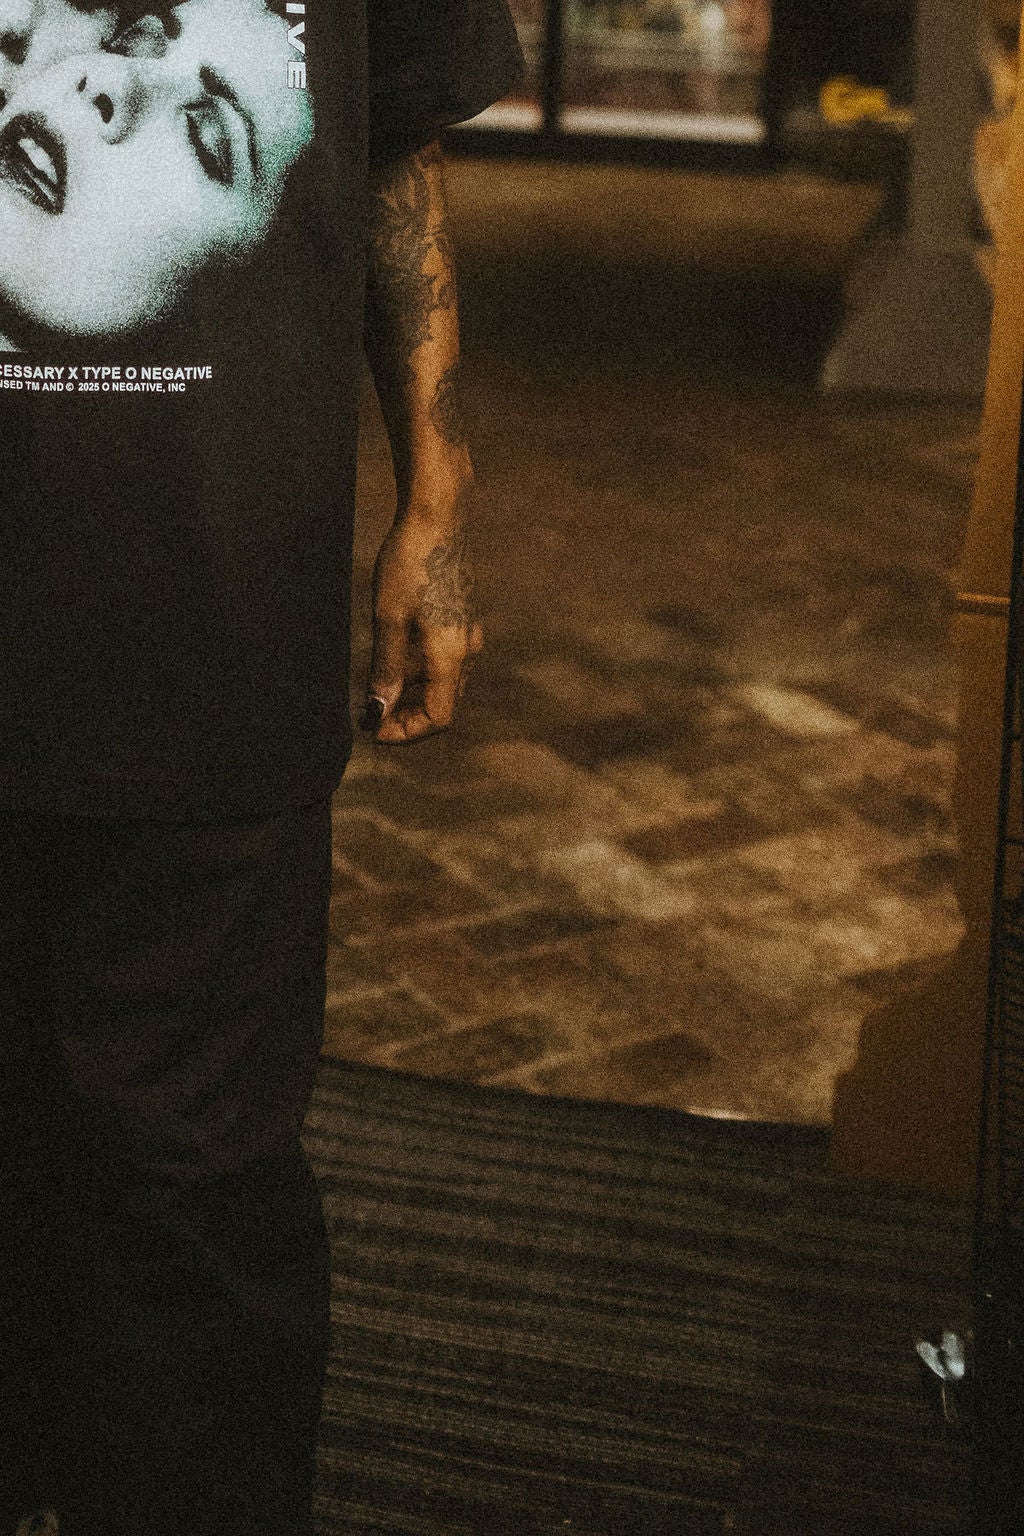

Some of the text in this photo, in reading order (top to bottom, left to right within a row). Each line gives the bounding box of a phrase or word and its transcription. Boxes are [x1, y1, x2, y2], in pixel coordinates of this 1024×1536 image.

[68, 366, 79, 380] X
[82, 366, 121, 380] TYPE
[125, 366, 137, 381] O
[141, 365, 212, 382] NEGATIVE
[25, 380, 40, 392] TM
[41, 381, 64, 392] AND
[77, 381, 101, 393] 2025
[102, 381, 111, 393] O
[112, 381, 167, 394] NEGATIVE,
[168, 382, 187, 393] INC
